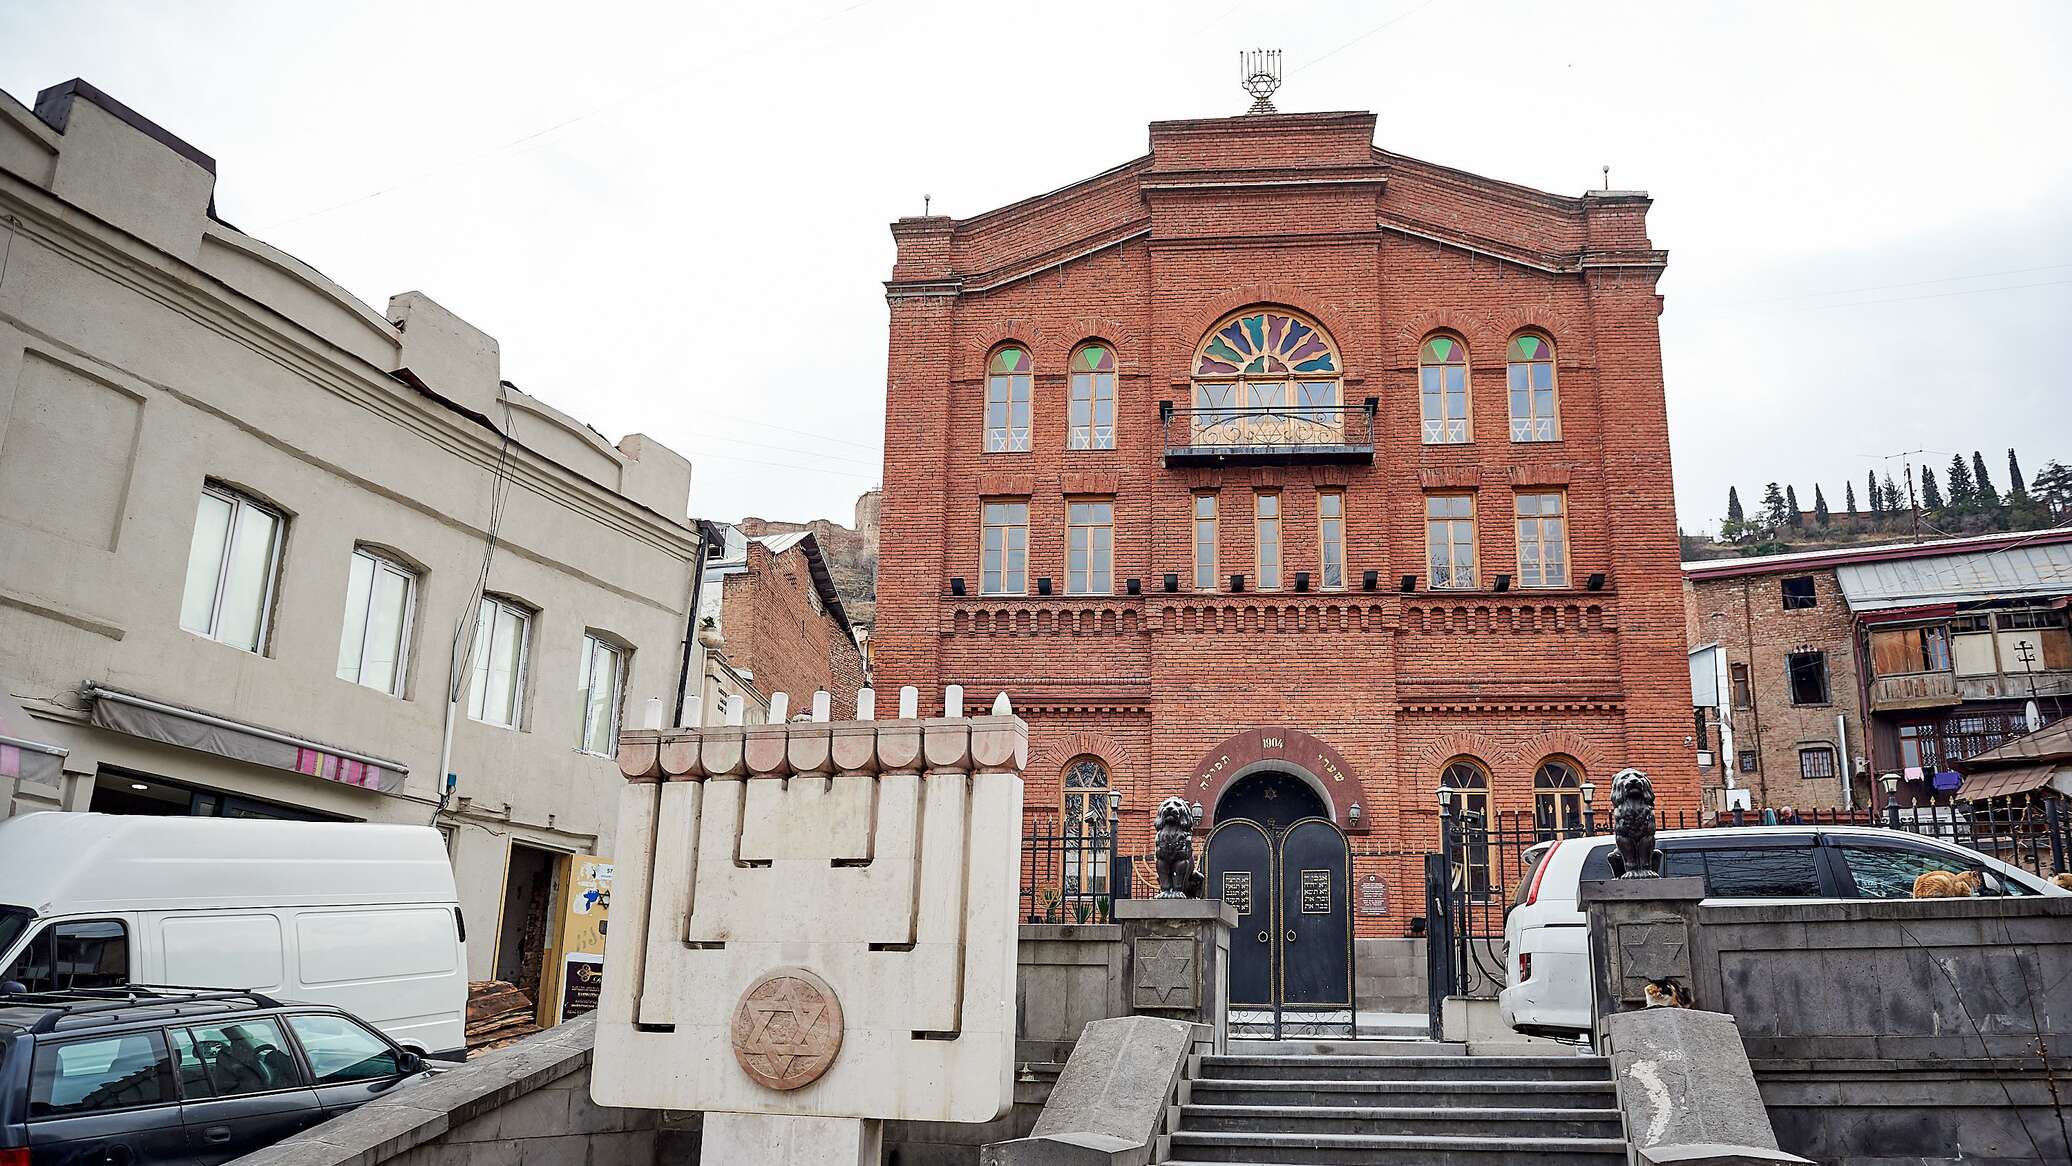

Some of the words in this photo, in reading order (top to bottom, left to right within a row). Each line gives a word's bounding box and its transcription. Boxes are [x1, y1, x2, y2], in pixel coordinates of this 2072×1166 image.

[1262, 737, 1284, 749] 1904
[1200, 754, 1230, 790] תפילה
[1317, 754, 1344, 782] שערי
